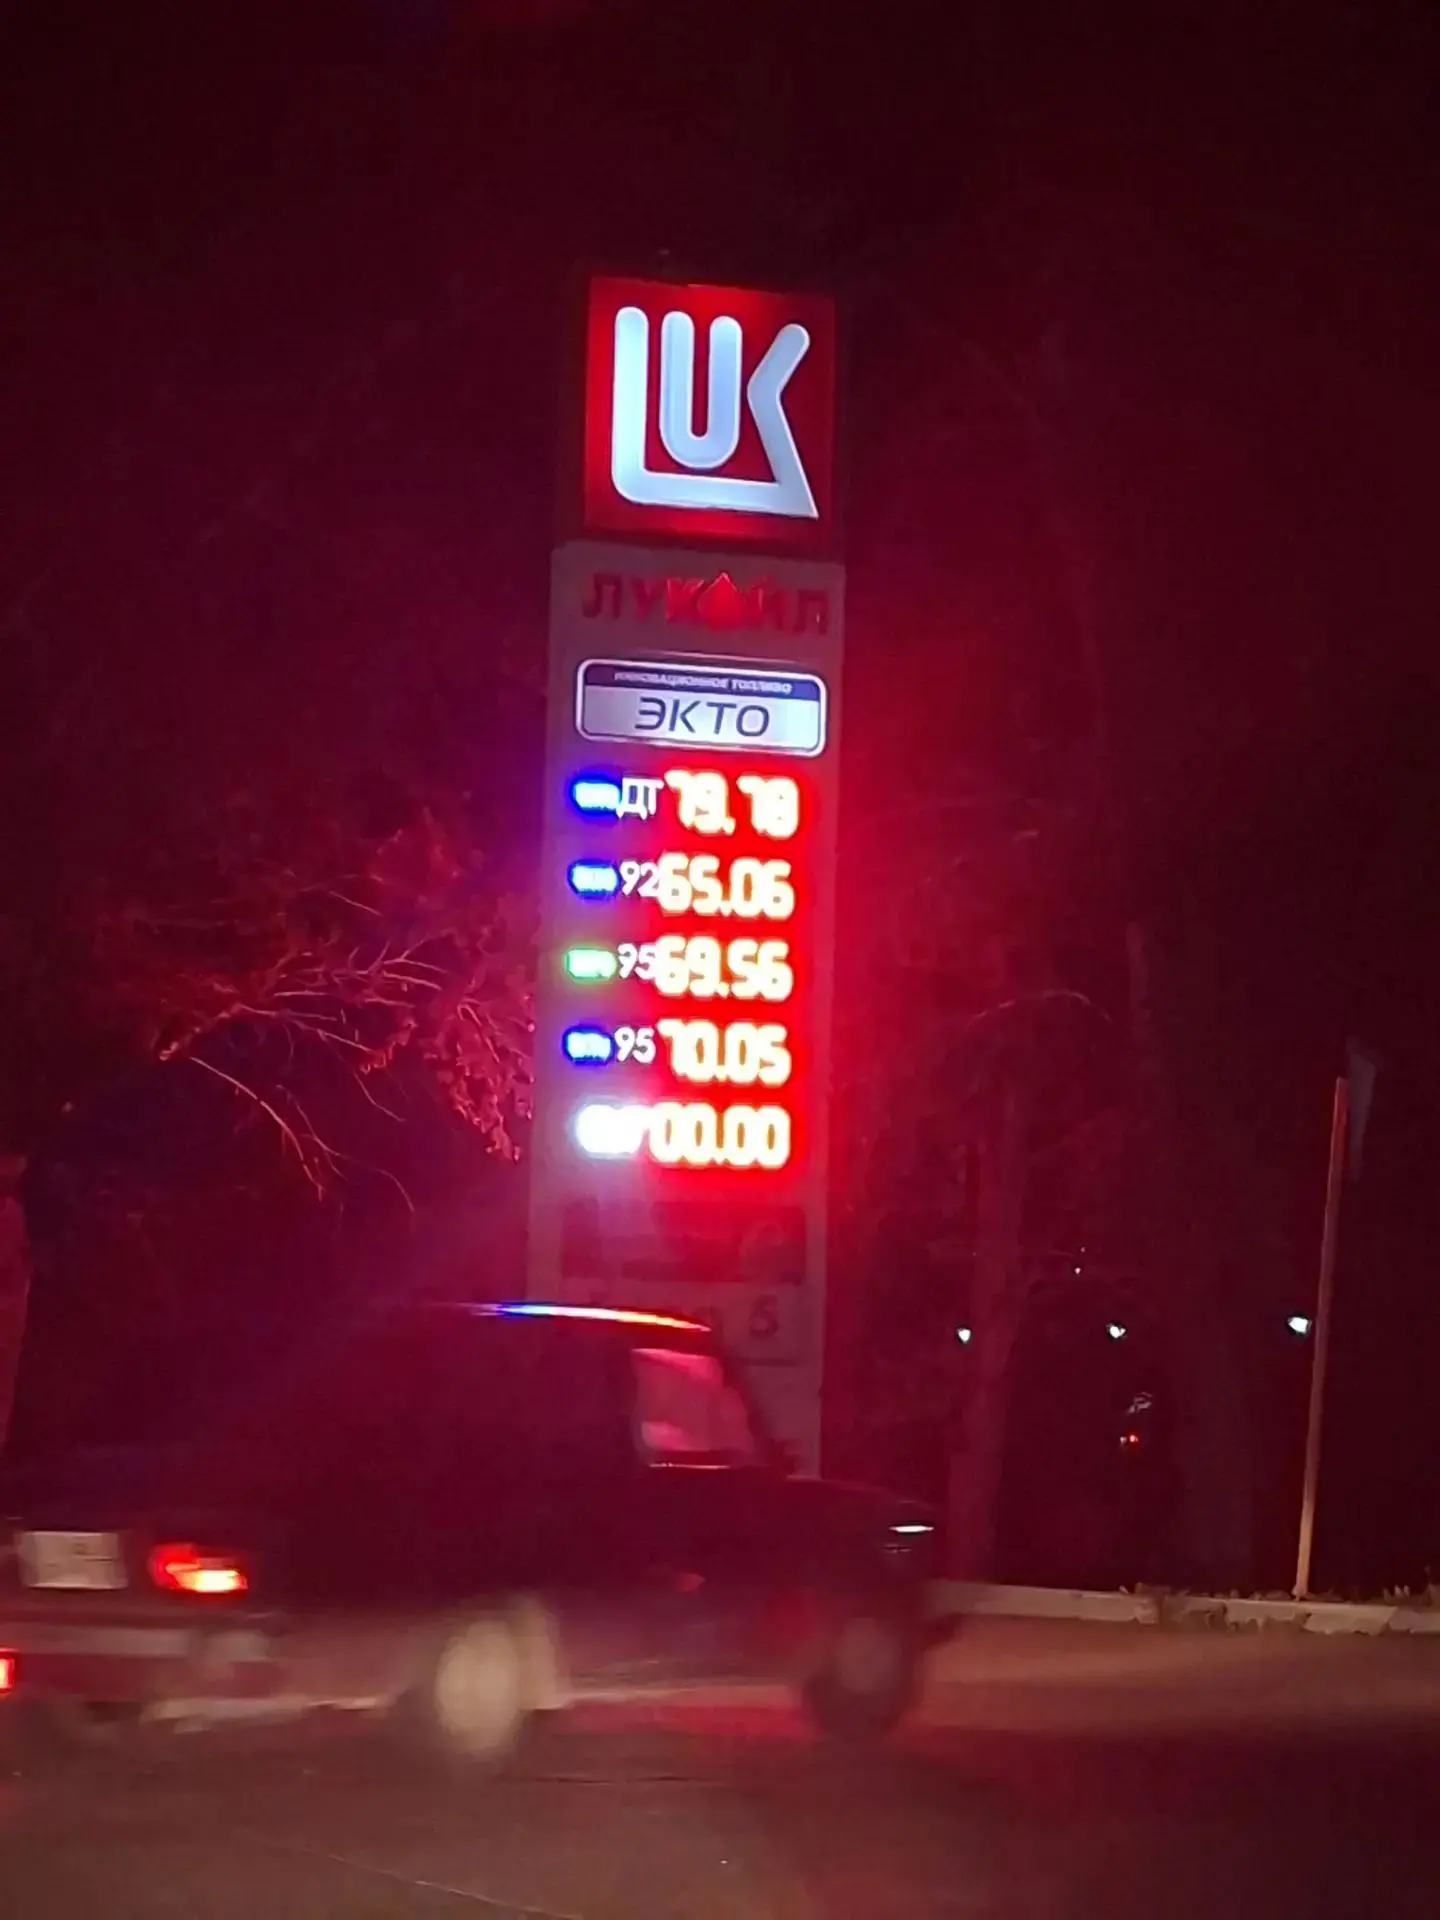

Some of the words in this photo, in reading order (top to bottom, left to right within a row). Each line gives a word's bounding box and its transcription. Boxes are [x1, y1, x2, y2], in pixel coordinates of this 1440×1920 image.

[634, 696, 770, 737] ЭКТО
[617, 778, 664, 820] ДТ
[620, 860, 660, 897] 92
[657, 853, 794, 917] 65.06
[618, 943, 657, 980] 95
[654, 936, 793, 999] 69.56
[614, 1026, 656, 1063] 95
[657, 1019, 792, 1084] 70.05
[649, 1102, 791, 1167] 00.00
